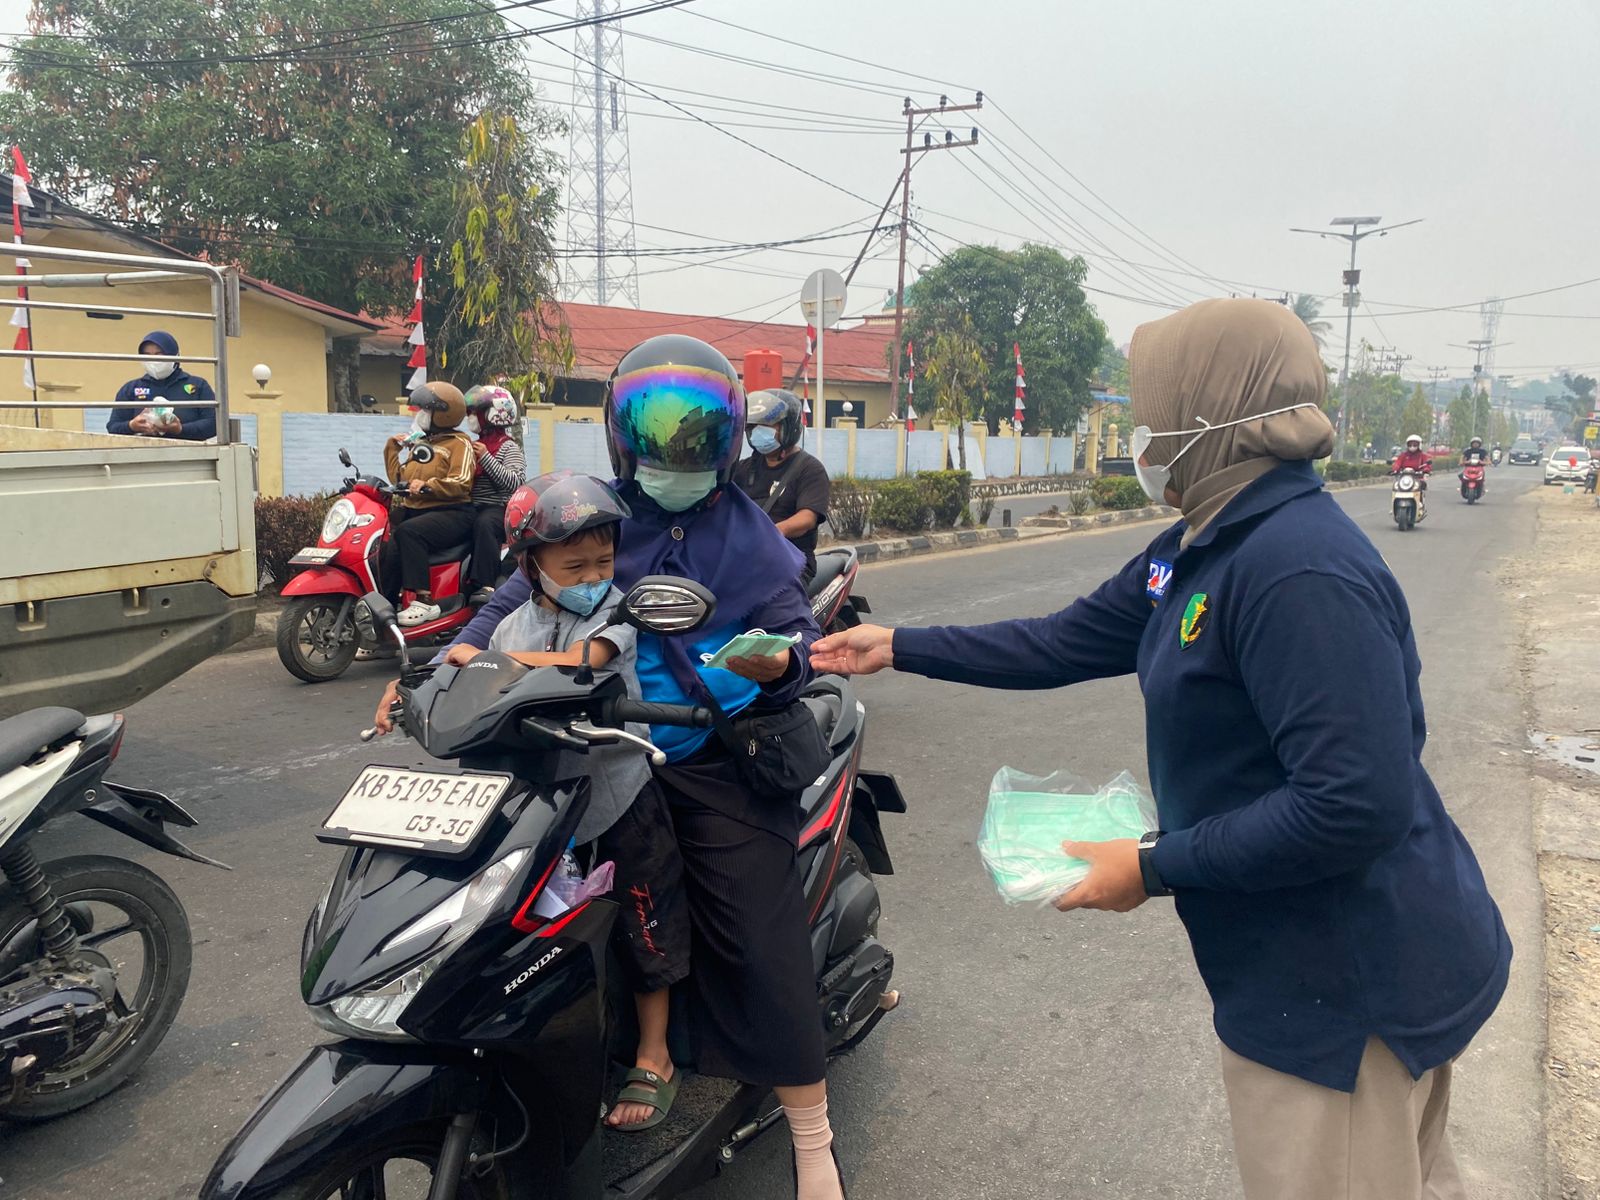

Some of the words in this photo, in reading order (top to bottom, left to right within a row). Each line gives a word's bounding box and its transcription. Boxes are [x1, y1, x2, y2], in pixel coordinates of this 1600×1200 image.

[353, 773, 389, 798] KB
[386, 776, 450, 803] 5195
[443, 781, 498, 808] EAG
[504, 946, 562, 995] HONDA
